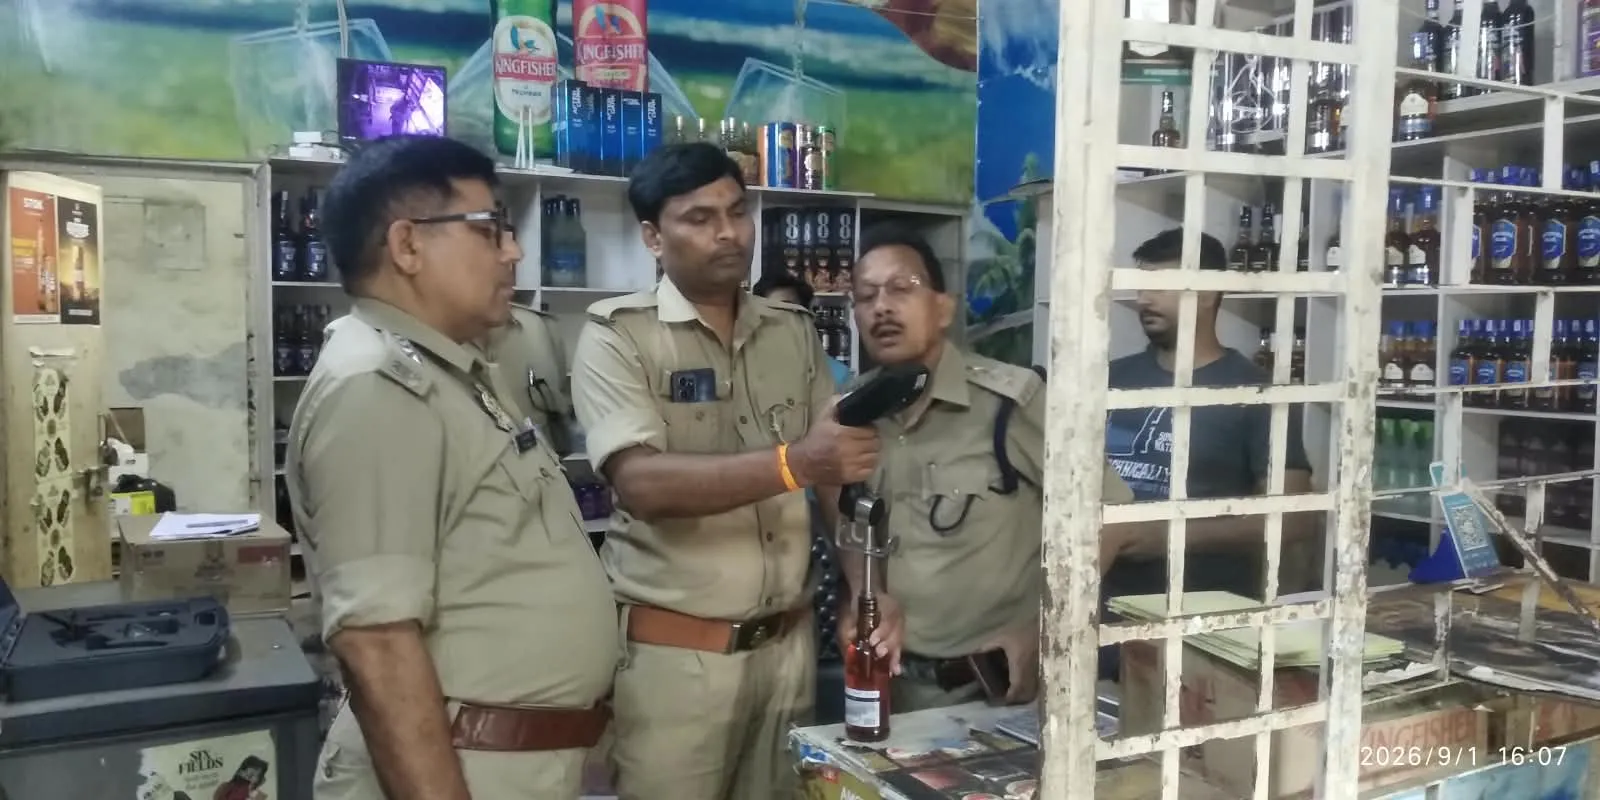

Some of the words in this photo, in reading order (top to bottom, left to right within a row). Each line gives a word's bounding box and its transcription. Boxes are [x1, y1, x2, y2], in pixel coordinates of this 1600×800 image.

[785, 213, 799, 239] 8
[817, 212, 829, 238] 8
[839, 213, 851, 239] 8
[178, 757, 224, 775] FIELDS
